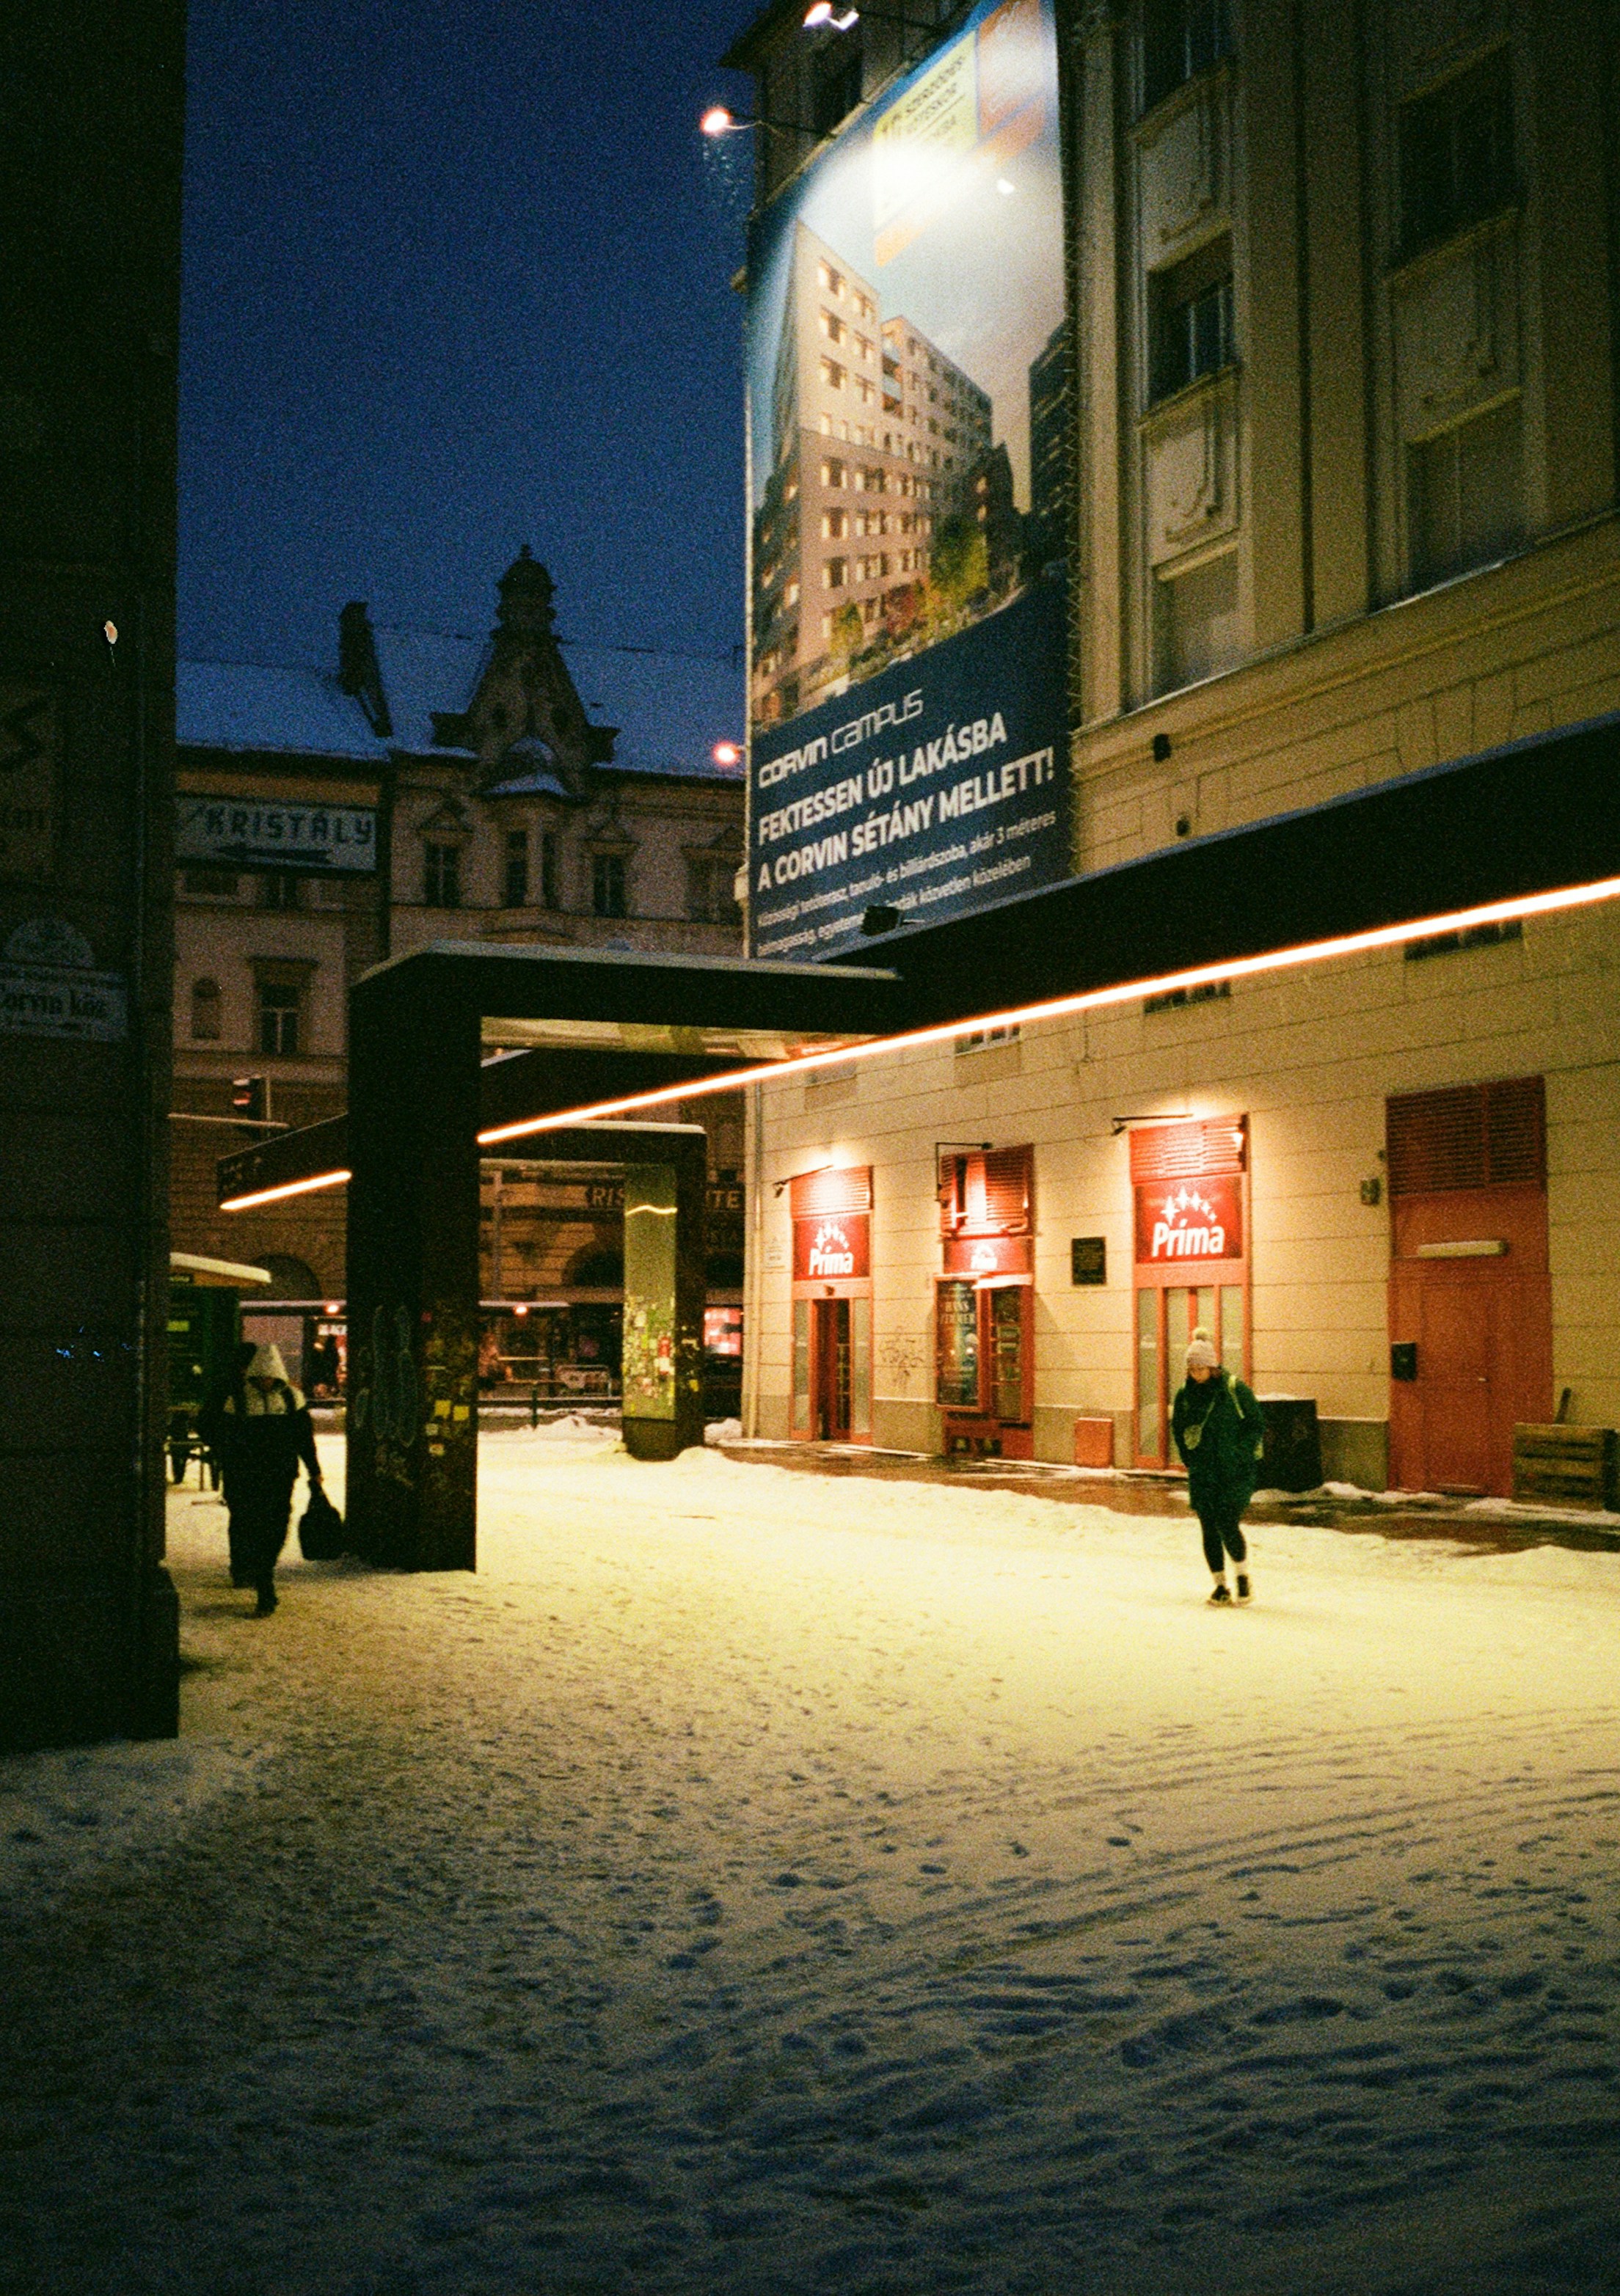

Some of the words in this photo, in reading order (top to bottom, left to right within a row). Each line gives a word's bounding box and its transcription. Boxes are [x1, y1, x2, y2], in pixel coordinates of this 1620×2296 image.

[758, 862, 772, 892] A
[774, 830, 848, 885] CORVIN
[851, 794, 935, 858] SÉTÁNY
[938, 746, 1055, 824] MELLETT!
[759, 774, 863, 847] FEKTESSEN
[867, 757, 894, 800] ÚJ
[899, 712, 1007, 786] LAKÁSBA
[995, 827, 1005, 845] 3
